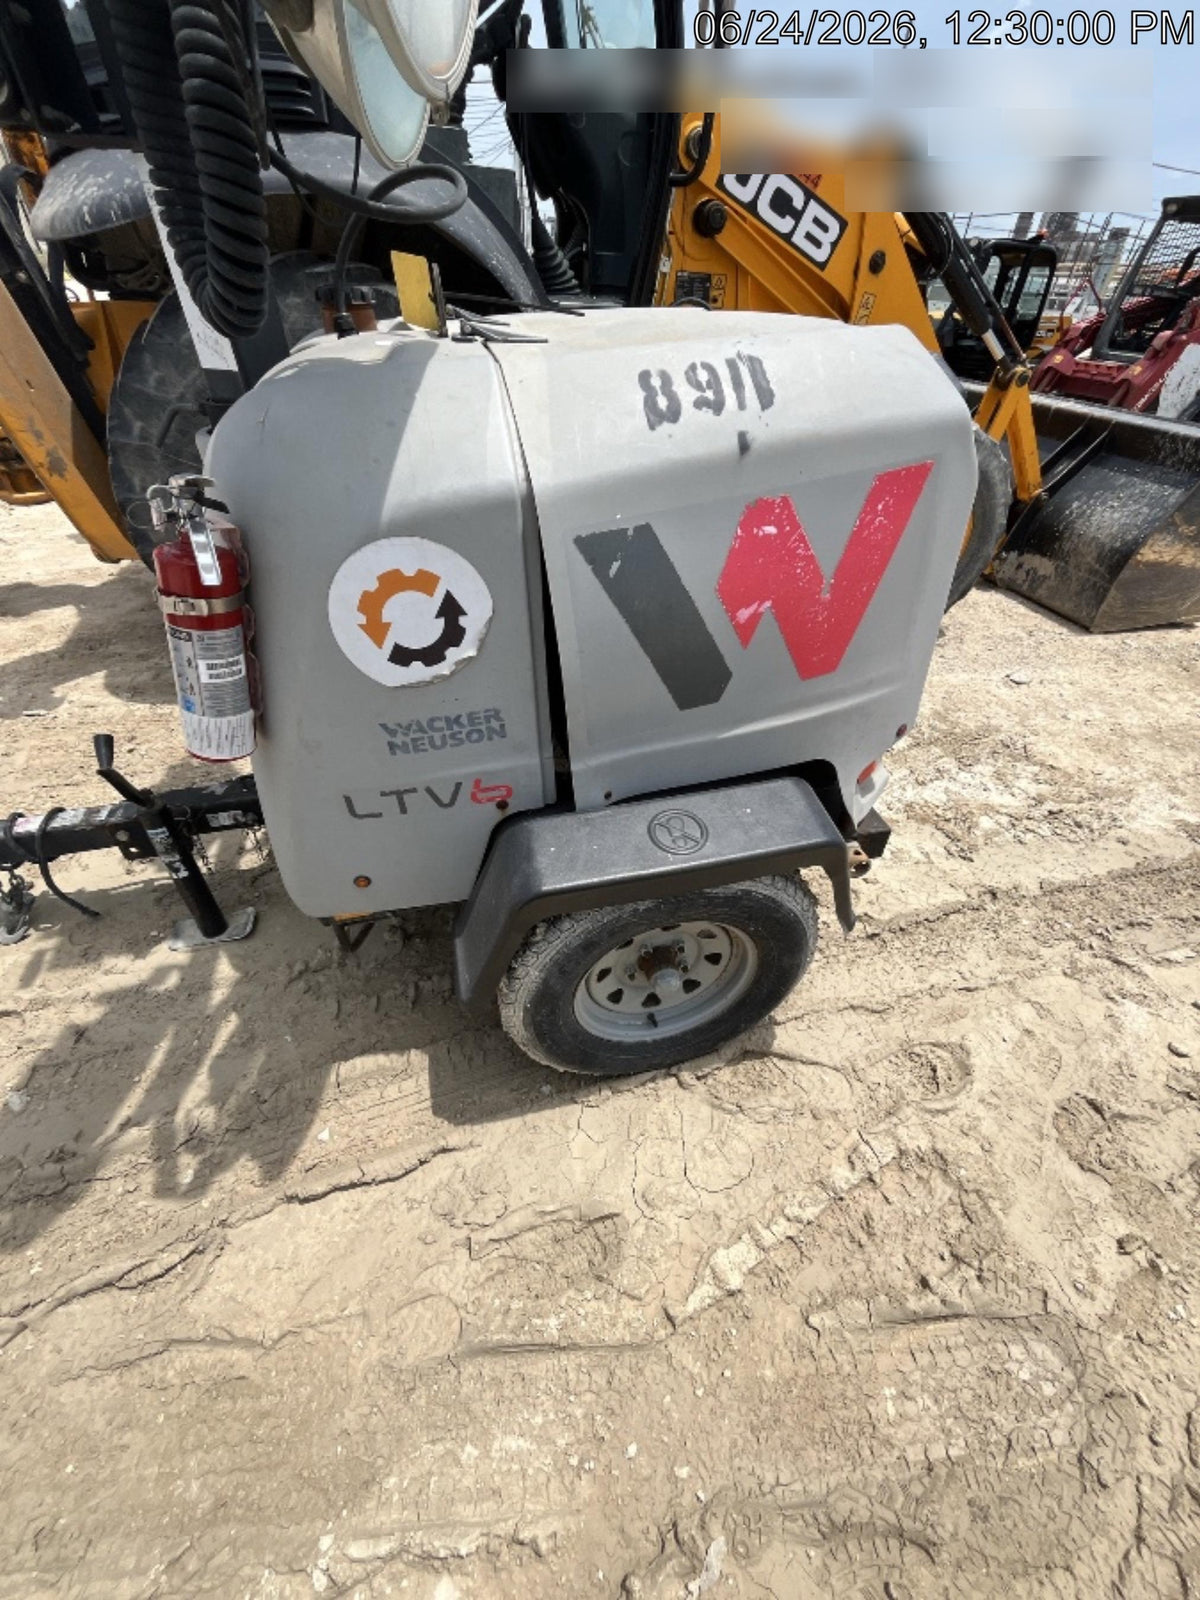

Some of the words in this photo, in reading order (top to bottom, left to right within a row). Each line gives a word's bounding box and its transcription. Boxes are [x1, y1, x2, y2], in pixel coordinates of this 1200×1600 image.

[722, 173, 840, 262] JCB
[378, 708, 505, 738] WACKER
[387, 722, 507, 756] NEUSON
